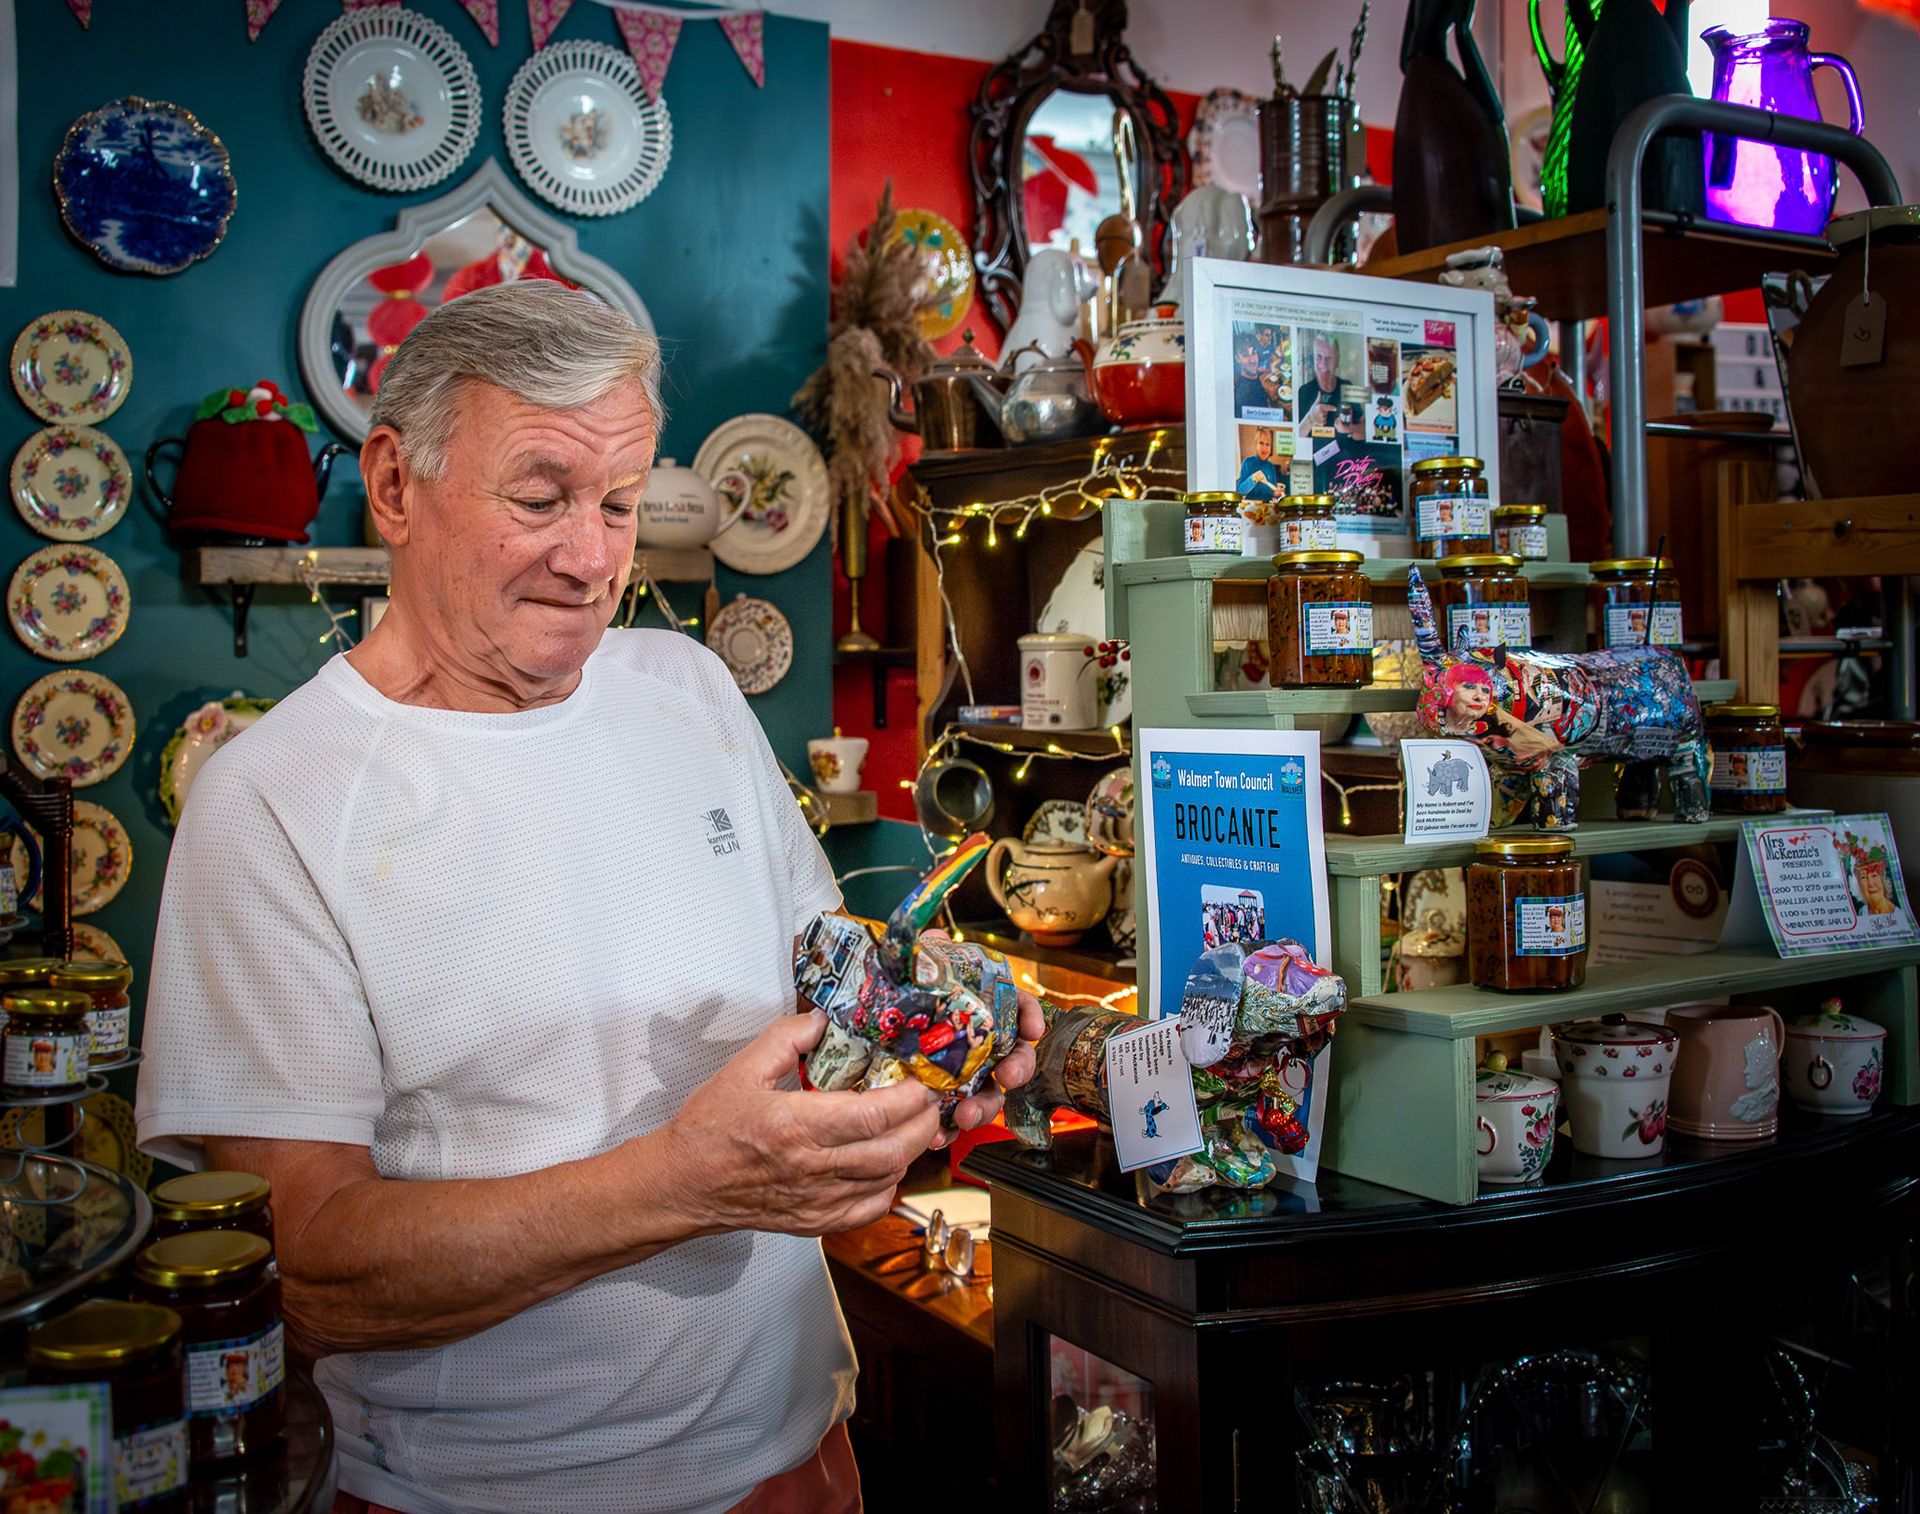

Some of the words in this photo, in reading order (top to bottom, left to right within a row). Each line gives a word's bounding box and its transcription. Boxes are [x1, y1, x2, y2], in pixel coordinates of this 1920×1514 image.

[1336, 455, 1376, 478] Dirty
[1343, 467, 1384, 489] Dancing
[1177, 768, 1212, 788] Walmer
[1214, 770, 1238, 790] Town
[1240, 772, 1274, 791] Council
[1281, 784, 1303, 795] WALMER
[1175, 803, 1280, 848] BROCANTE
[712, 840, 740, 856] RUN
[1766, 846, 1820, 861] McKenzie's
[1181, 853, 1205, 866] ANTIQUES,
[1206, 856, 1242, 870] COLLECTIBLES
[1243, 861, 1249, 870] &
[1250, 860, 1266, 872] CRAFT
[1267, 862, 1280, 874] FAIR
[1782, 859, 1824, 868] PRESERVES
[1780, 873, 1804, 881] SMALL
[1772, 886, 1791, 894] (200
[1805, 884, 1821, 892] 275
[1823, 882, 1844, 891] grams)
[1775, 897, 1809, 906] SMALLER
[1826, 894, 1847, 902] £1.50
[1780, 910, 1800, 918] (100
[1827, 906, 1849, 914] grams)
[1786, 919, 1826, 929] MINIATURE
[1165, 1028, 1171, 1039] My
[1118, 1044, 1124, 1054] NB
[1138, 1052, 1144, 1061] by
[1147, 1069, 1152, 1077] in
